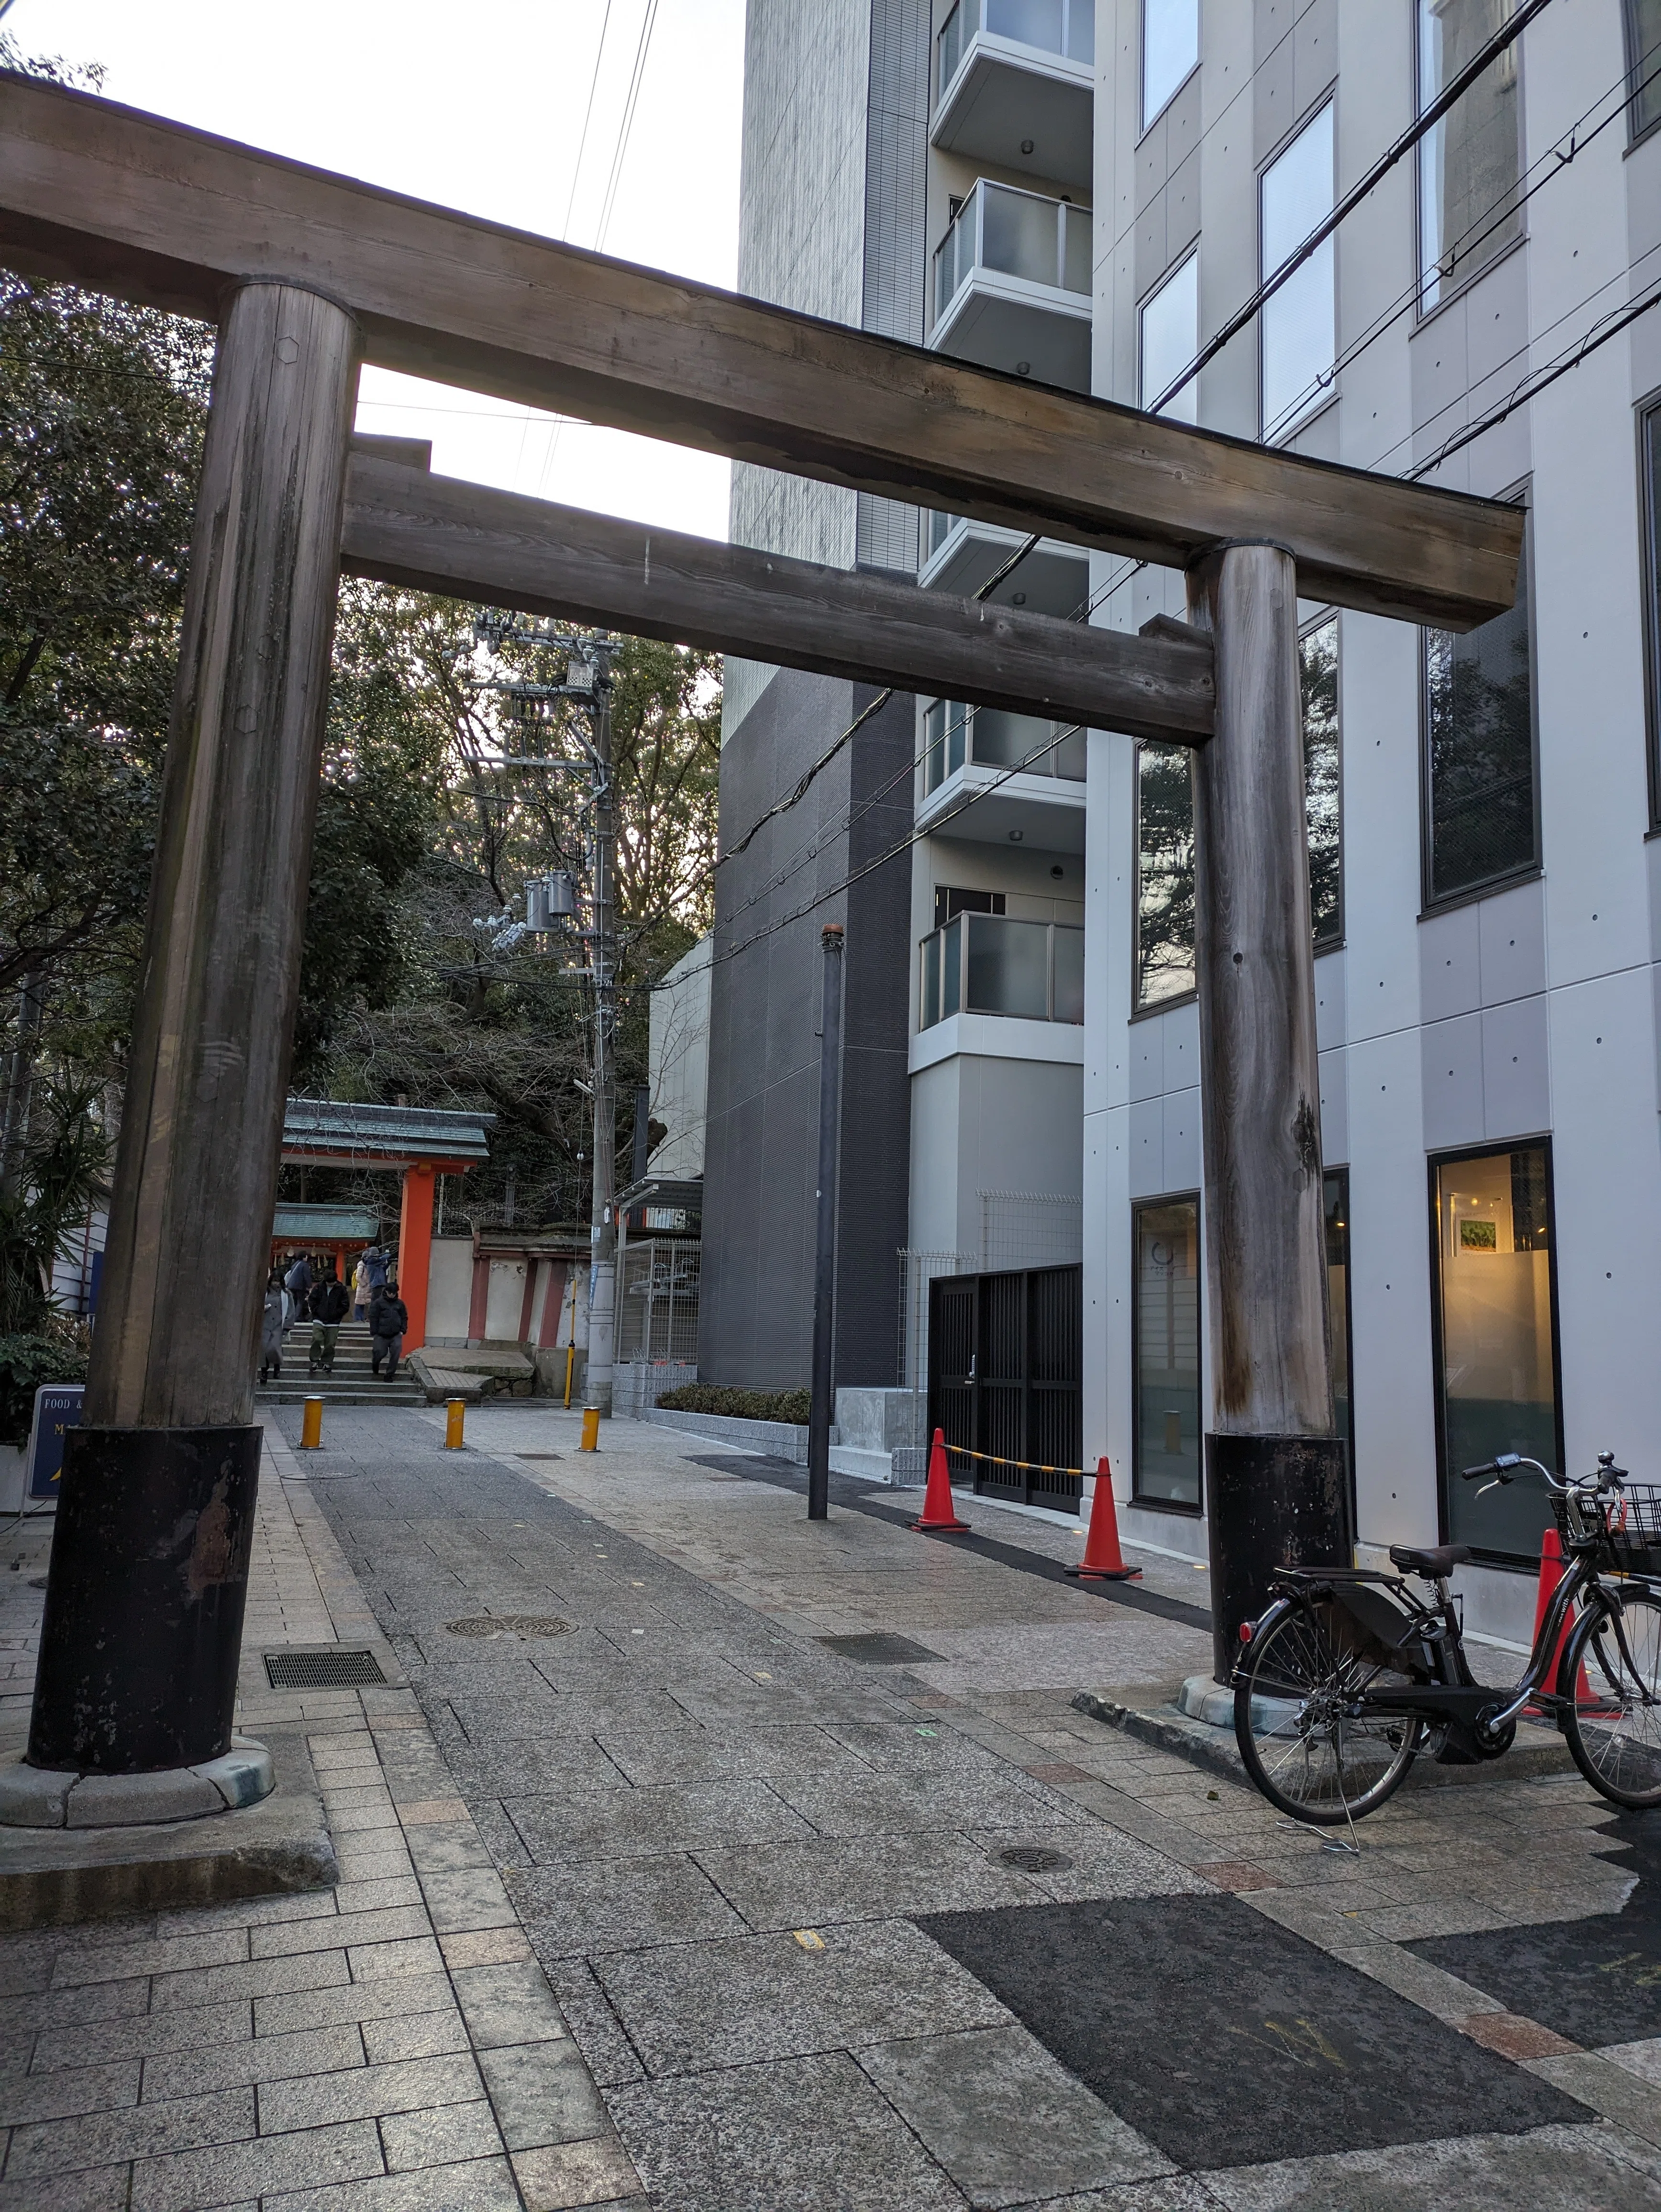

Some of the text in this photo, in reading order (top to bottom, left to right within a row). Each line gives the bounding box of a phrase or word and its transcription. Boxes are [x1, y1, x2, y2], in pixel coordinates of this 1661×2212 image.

[44, 1398, 82, 1409] FOOD &
[1561, 1598, 1570, 1613] with
